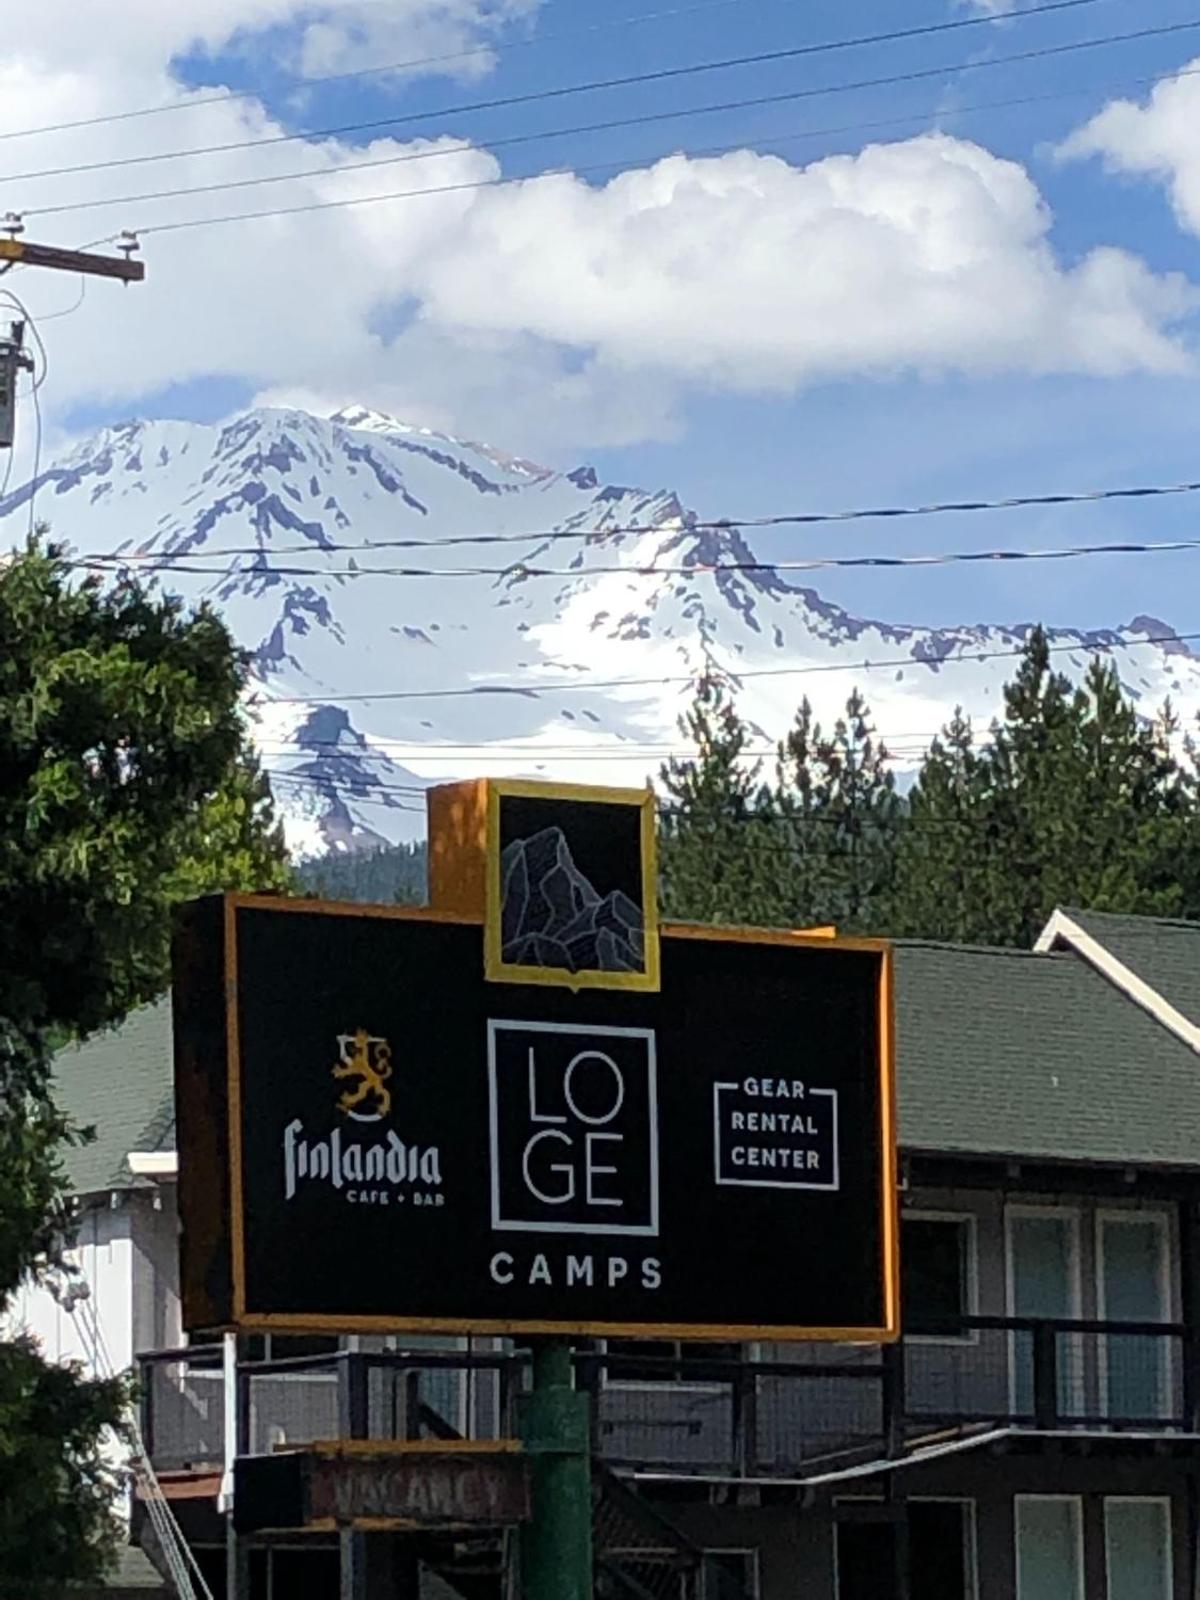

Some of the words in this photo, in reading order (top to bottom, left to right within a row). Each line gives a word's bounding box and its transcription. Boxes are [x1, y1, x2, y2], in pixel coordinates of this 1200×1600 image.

[743, 1076, 805, 1100] GEAR
[731, 1111, 819, 1135] RENTAL
[731, 1146, 820, 1170] CENTER
[346, 1189, 389, 1205] CAFE
[413, 1192, 445, 1207] BAR
[489, 1251, 662, 1289] CAMPS
